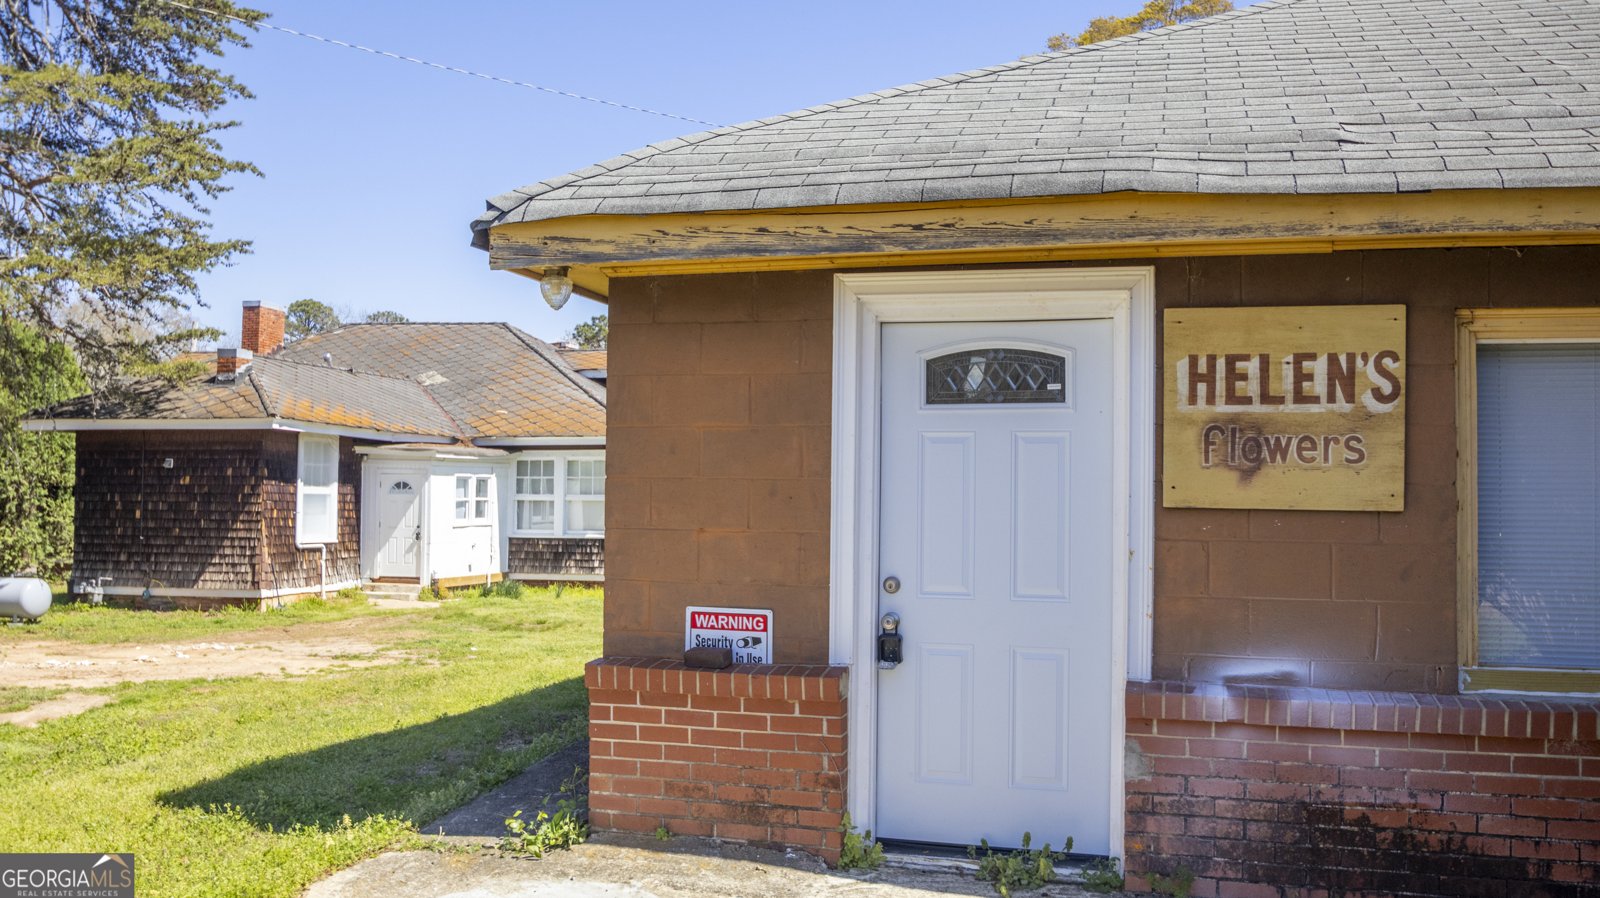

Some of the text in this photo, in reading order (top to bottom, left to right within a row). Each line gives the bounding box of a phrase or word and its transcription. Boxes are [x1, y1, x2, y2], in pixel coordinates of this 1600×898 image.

[1184, 350, 1401, 407] HELEN'S
[1203, 424, 1366, 466] flowers
[694, 614, 764, 630] WARNING
[695, 634, 733, 648] Security
[735, 652, 744, 664] in
